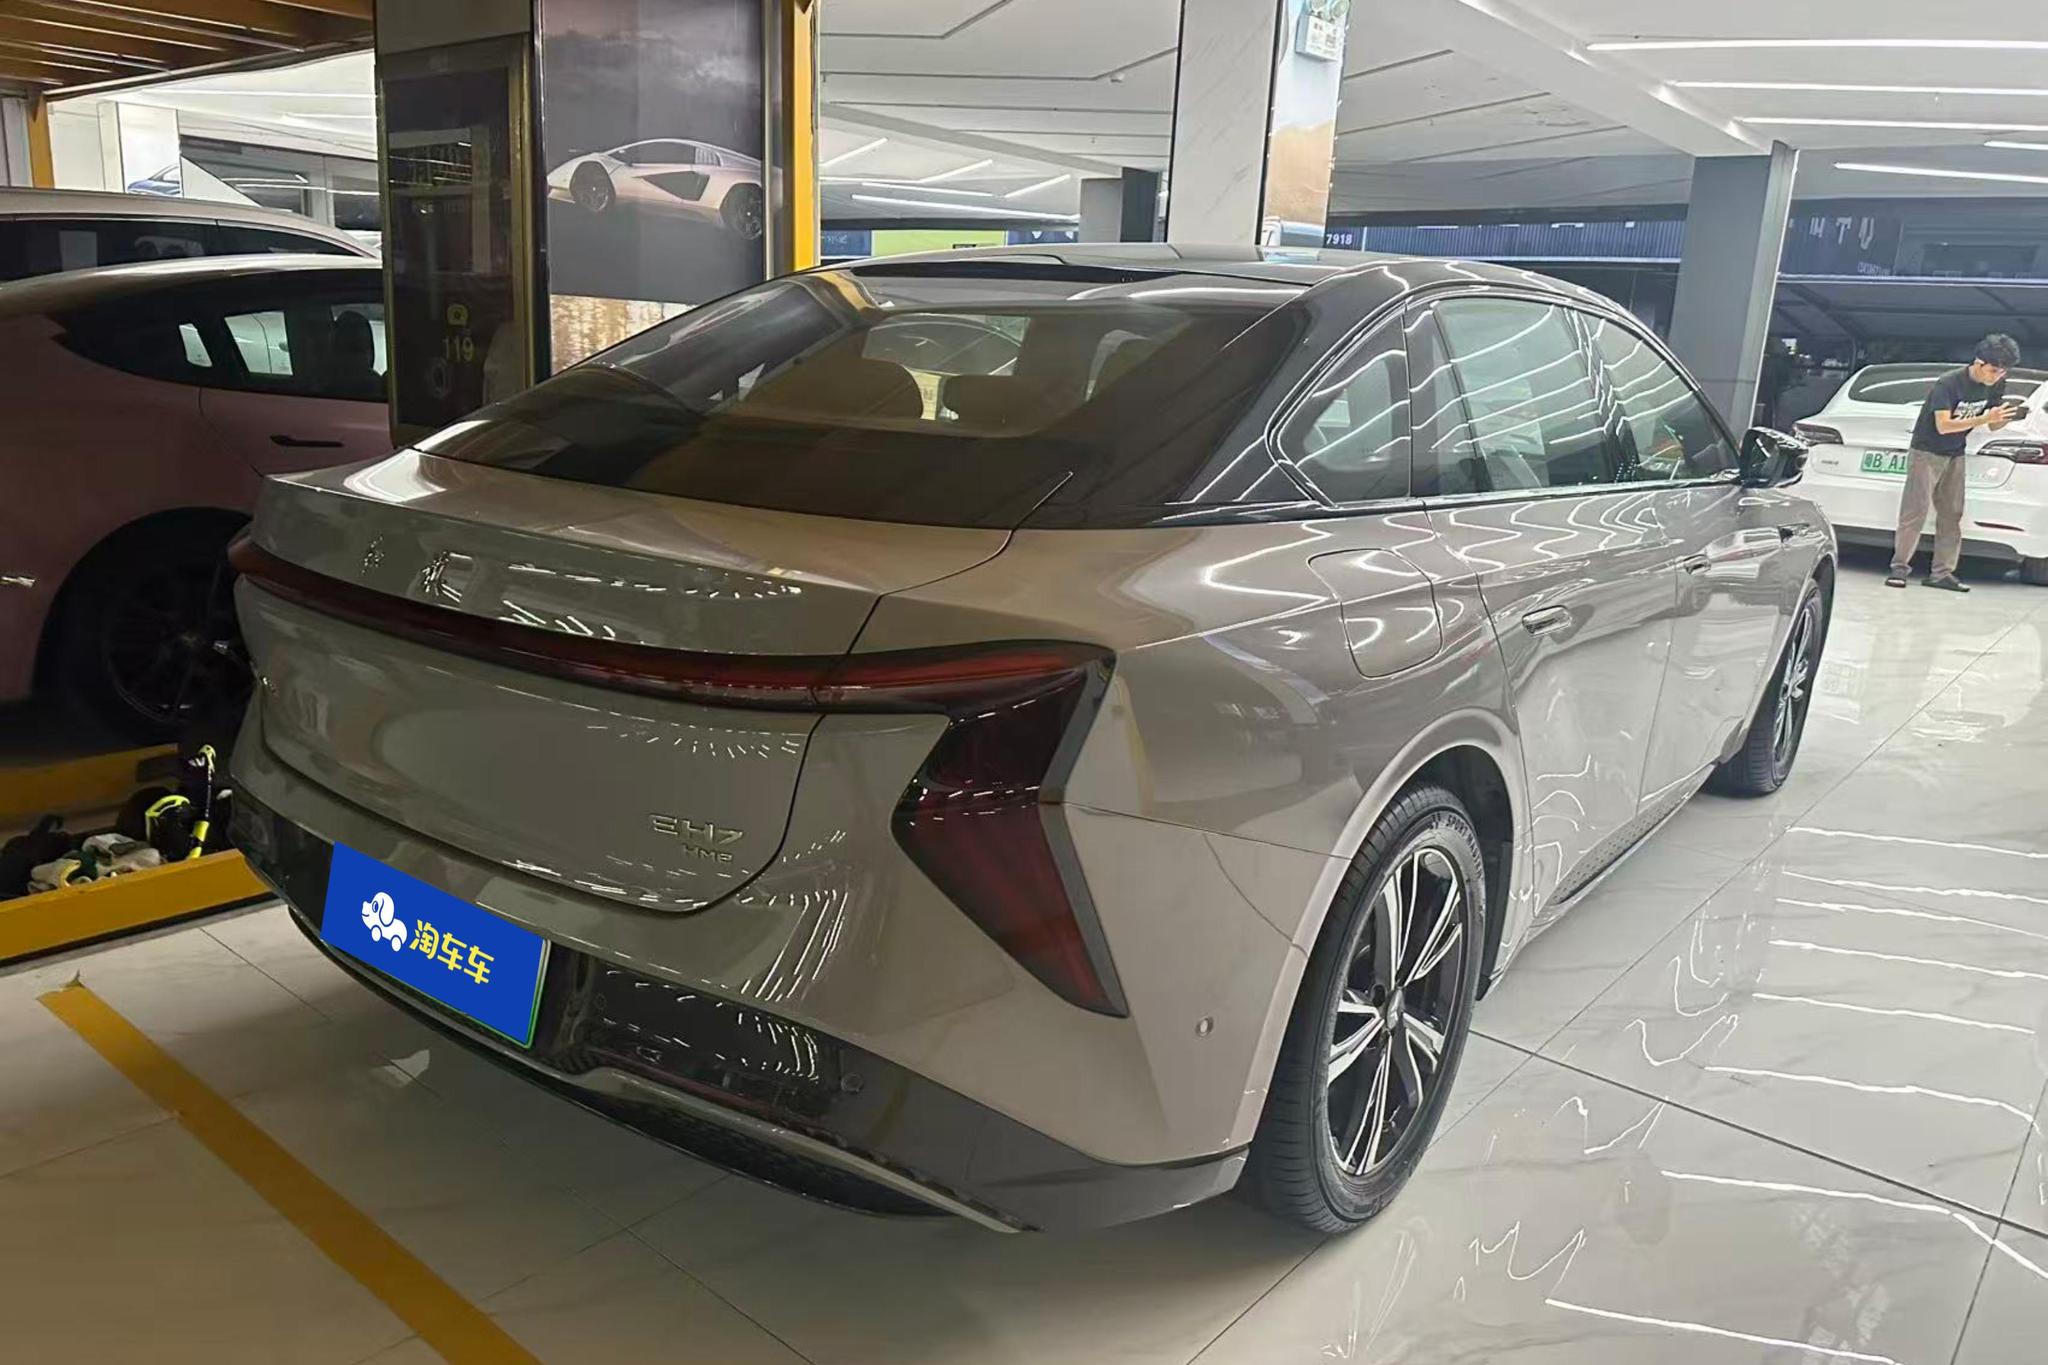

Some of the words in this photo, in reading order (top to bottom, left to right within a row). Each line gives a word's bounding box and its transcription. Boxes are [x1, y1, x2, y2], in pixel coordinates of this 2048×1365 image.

[1326, 233, 1353, 245] 7918
[441, 336, 473, 362] 119
[650, 813, 743, 845] EH7
